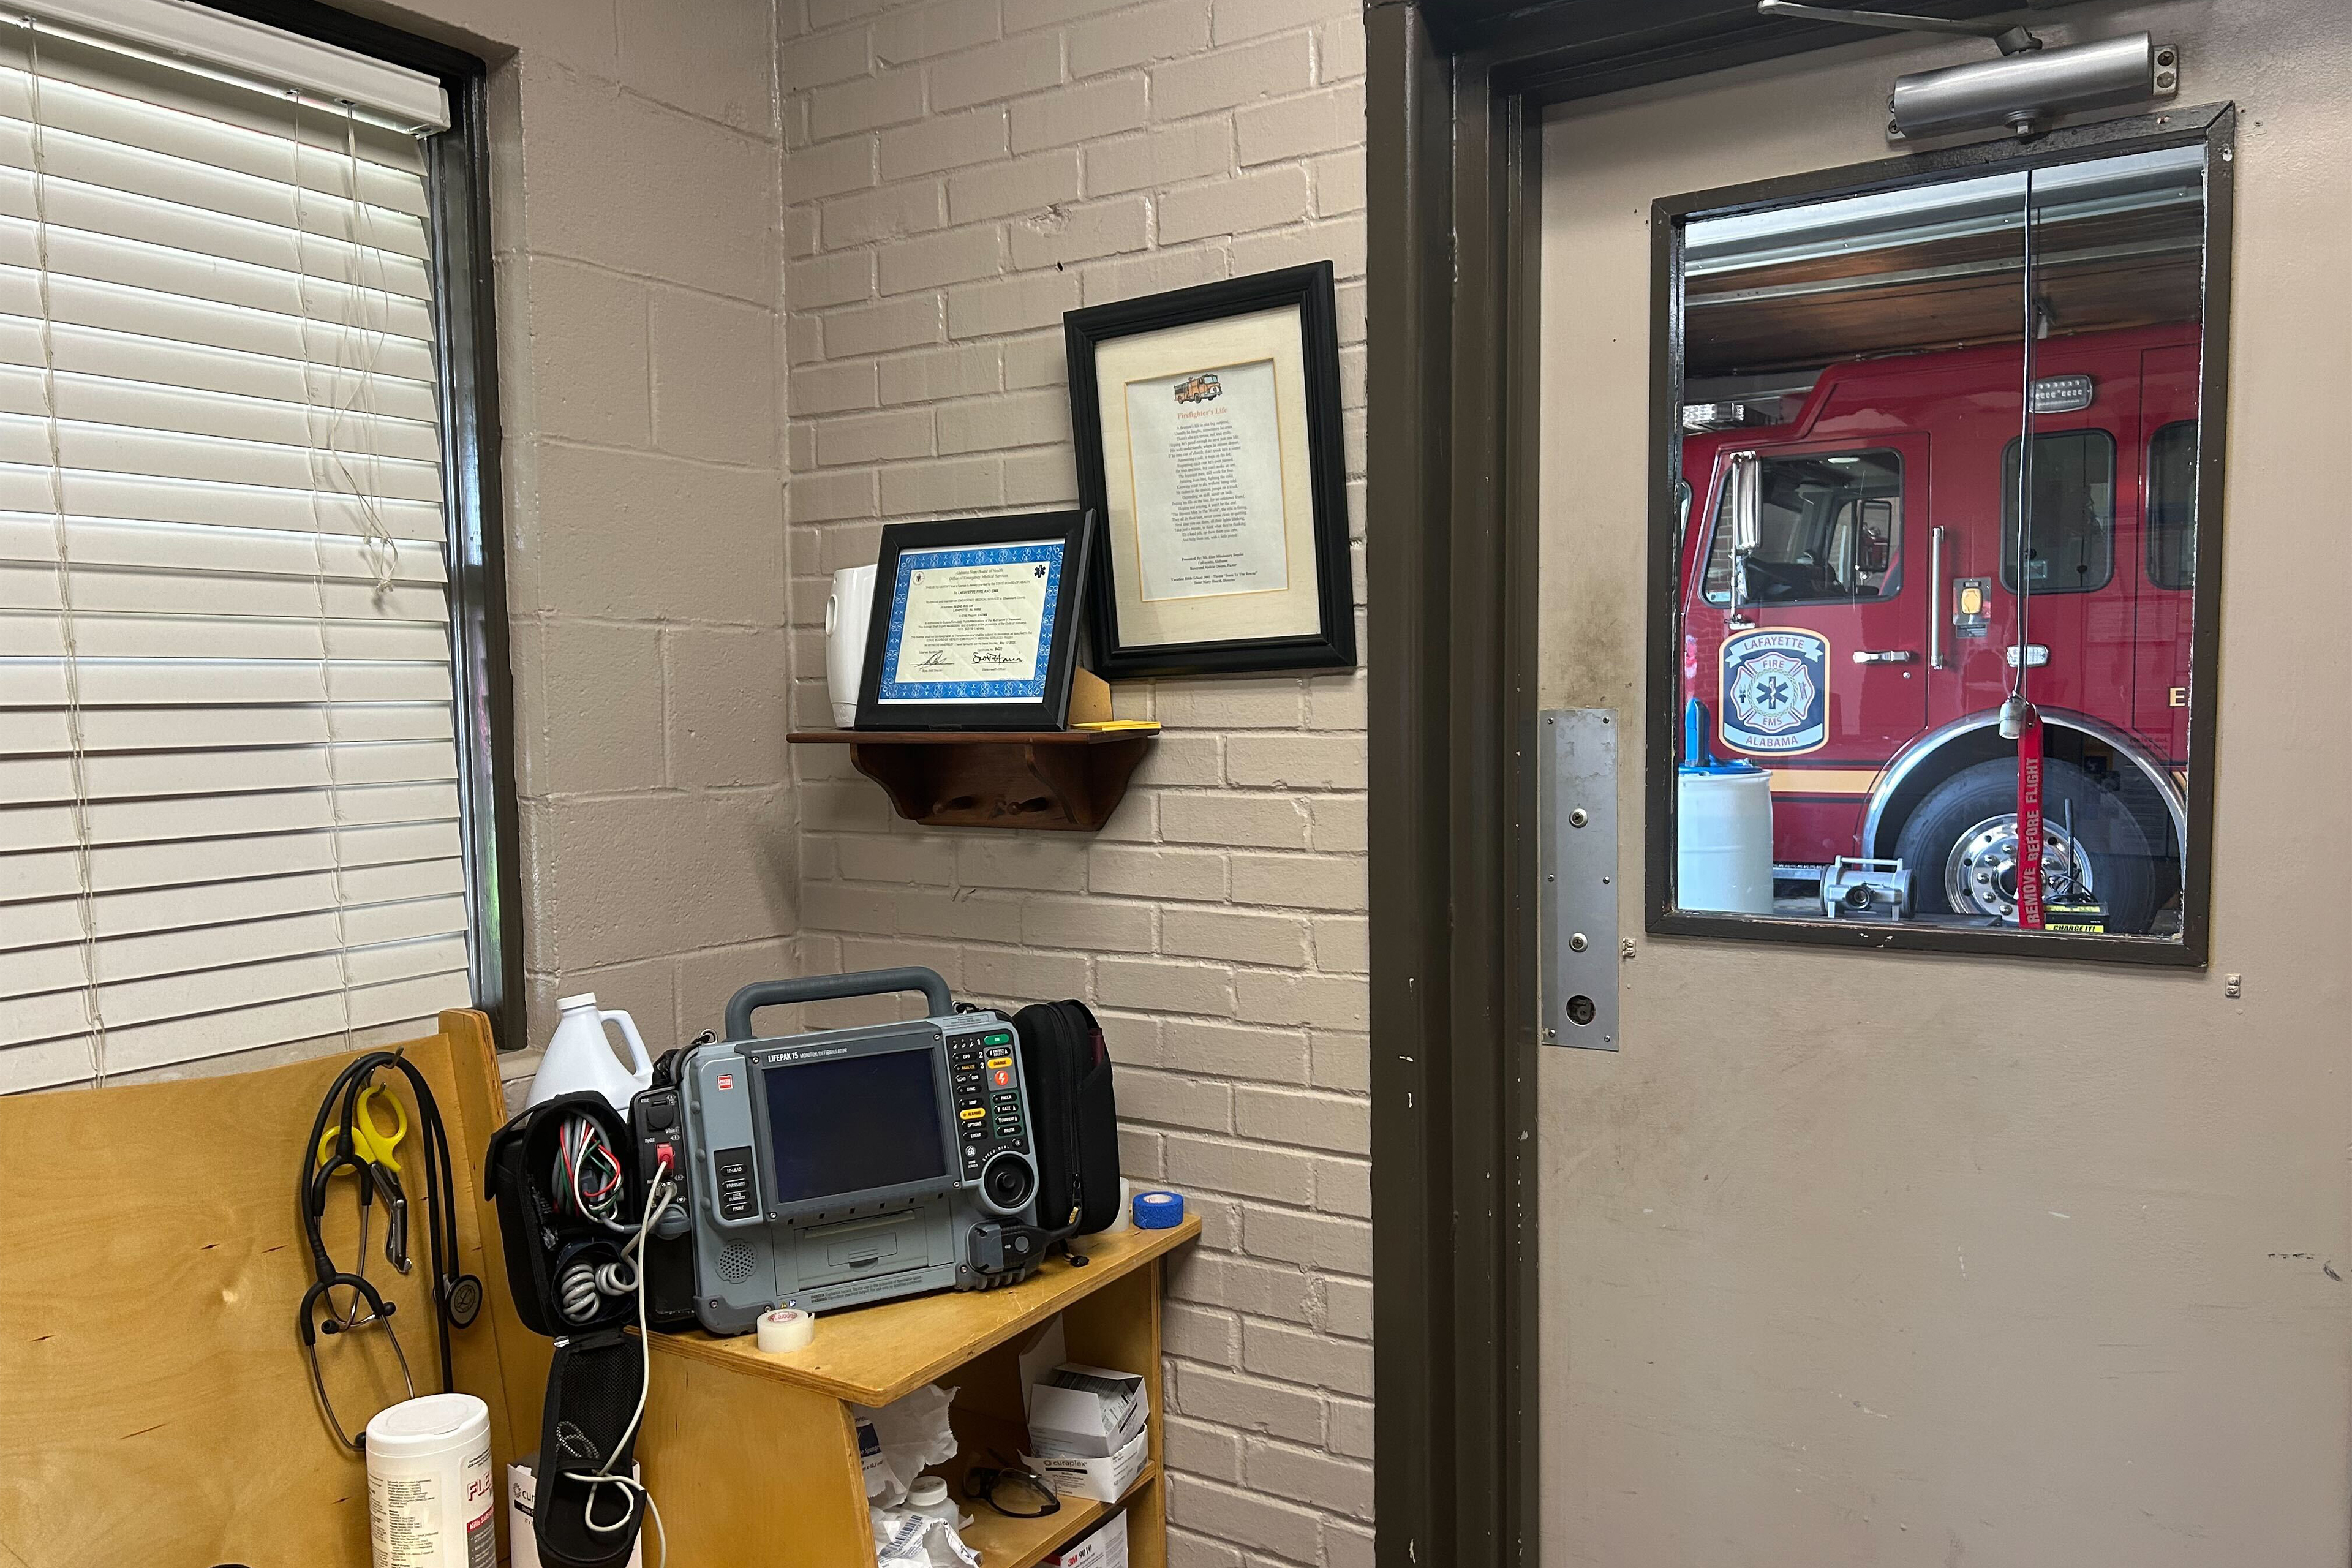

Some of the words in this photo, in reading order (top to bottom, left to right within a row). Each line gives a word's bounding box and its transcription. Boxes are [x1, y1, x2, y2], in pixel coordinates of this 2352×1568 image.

[1177, 408, 1213, 421] Firefighter's
[1215, 405, 1227, 414] Life
[1744, 636, 1804, 650] LAFAYETTE
[1763, 660, 1785, 668] FIRE
[2169, 687, 2185, 706] E
[1762, 717, 1782, 726] EMS
[1746, 736, 1798, 747] ALABAMA
[2026, 758, 2039, 804] FLIGHT
[2026, 810, 2040, 862] BEFORE
[2023, 867, 2040, 924] REMOVE
[768, 1054, 791, 1062] LIFEPAK
[799, 1048, 848, 1058] MONITOR/DEFIBRILLATOR
[470, 1520, 481, 1529] Kills
[1068, 1554, 1078, 1567] 3M
[1079, 1544, 1092, 1559] 9010
